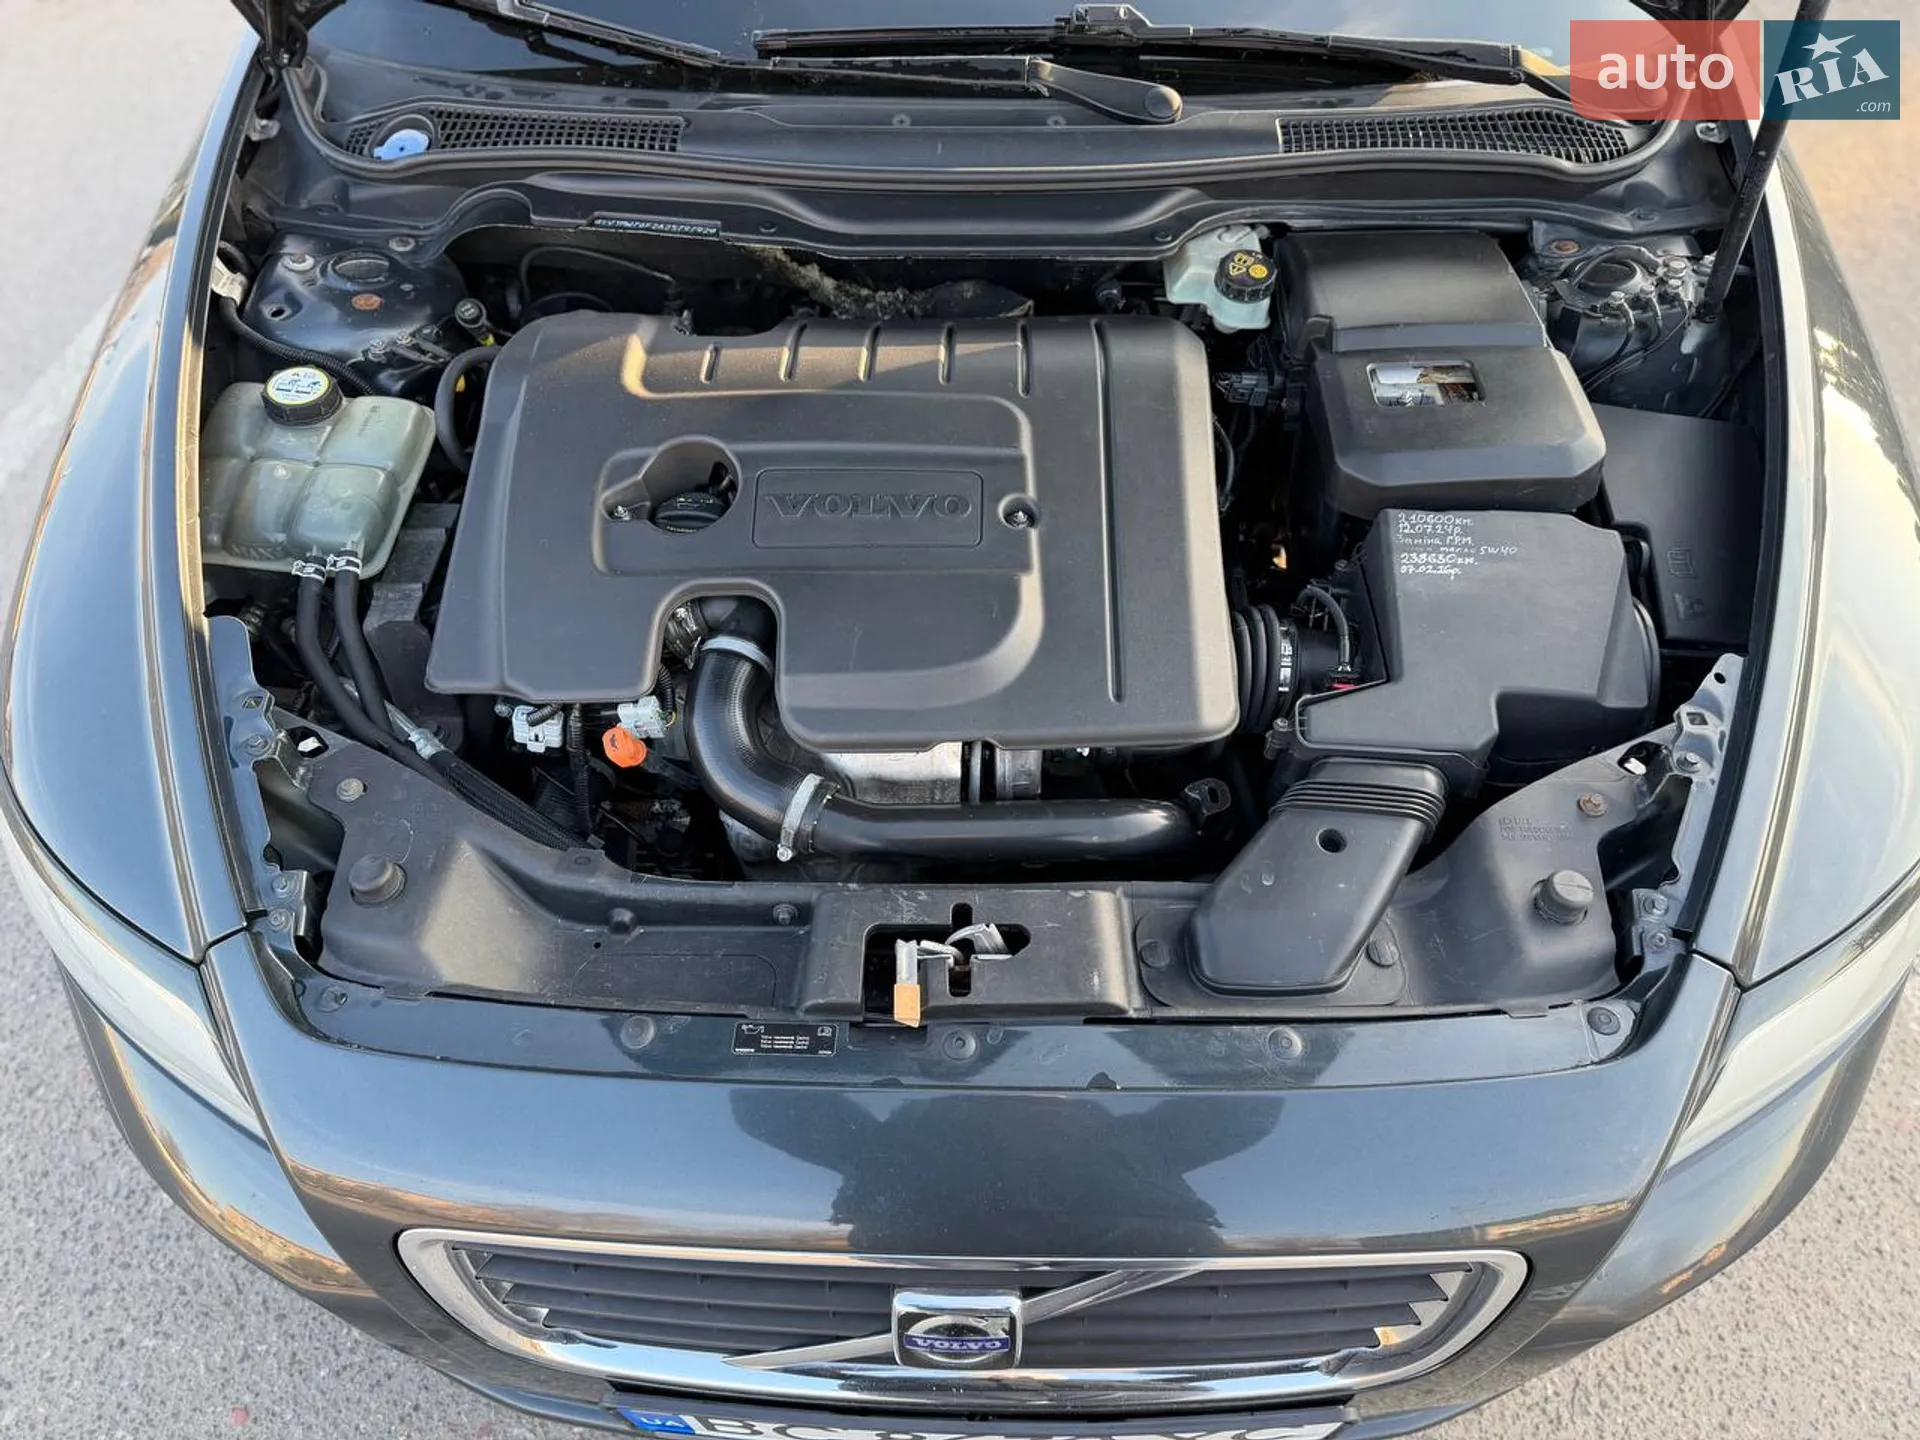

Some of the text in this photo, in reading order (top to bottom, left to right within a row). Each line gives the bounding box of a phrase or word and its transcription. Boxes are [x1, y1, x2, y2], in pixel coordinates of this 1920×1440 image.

[765, 492, 973, 518] VOLVO
[911, 1337, 1002, 1350] VOLVO
[640, 1416, 685, 1428] UA
